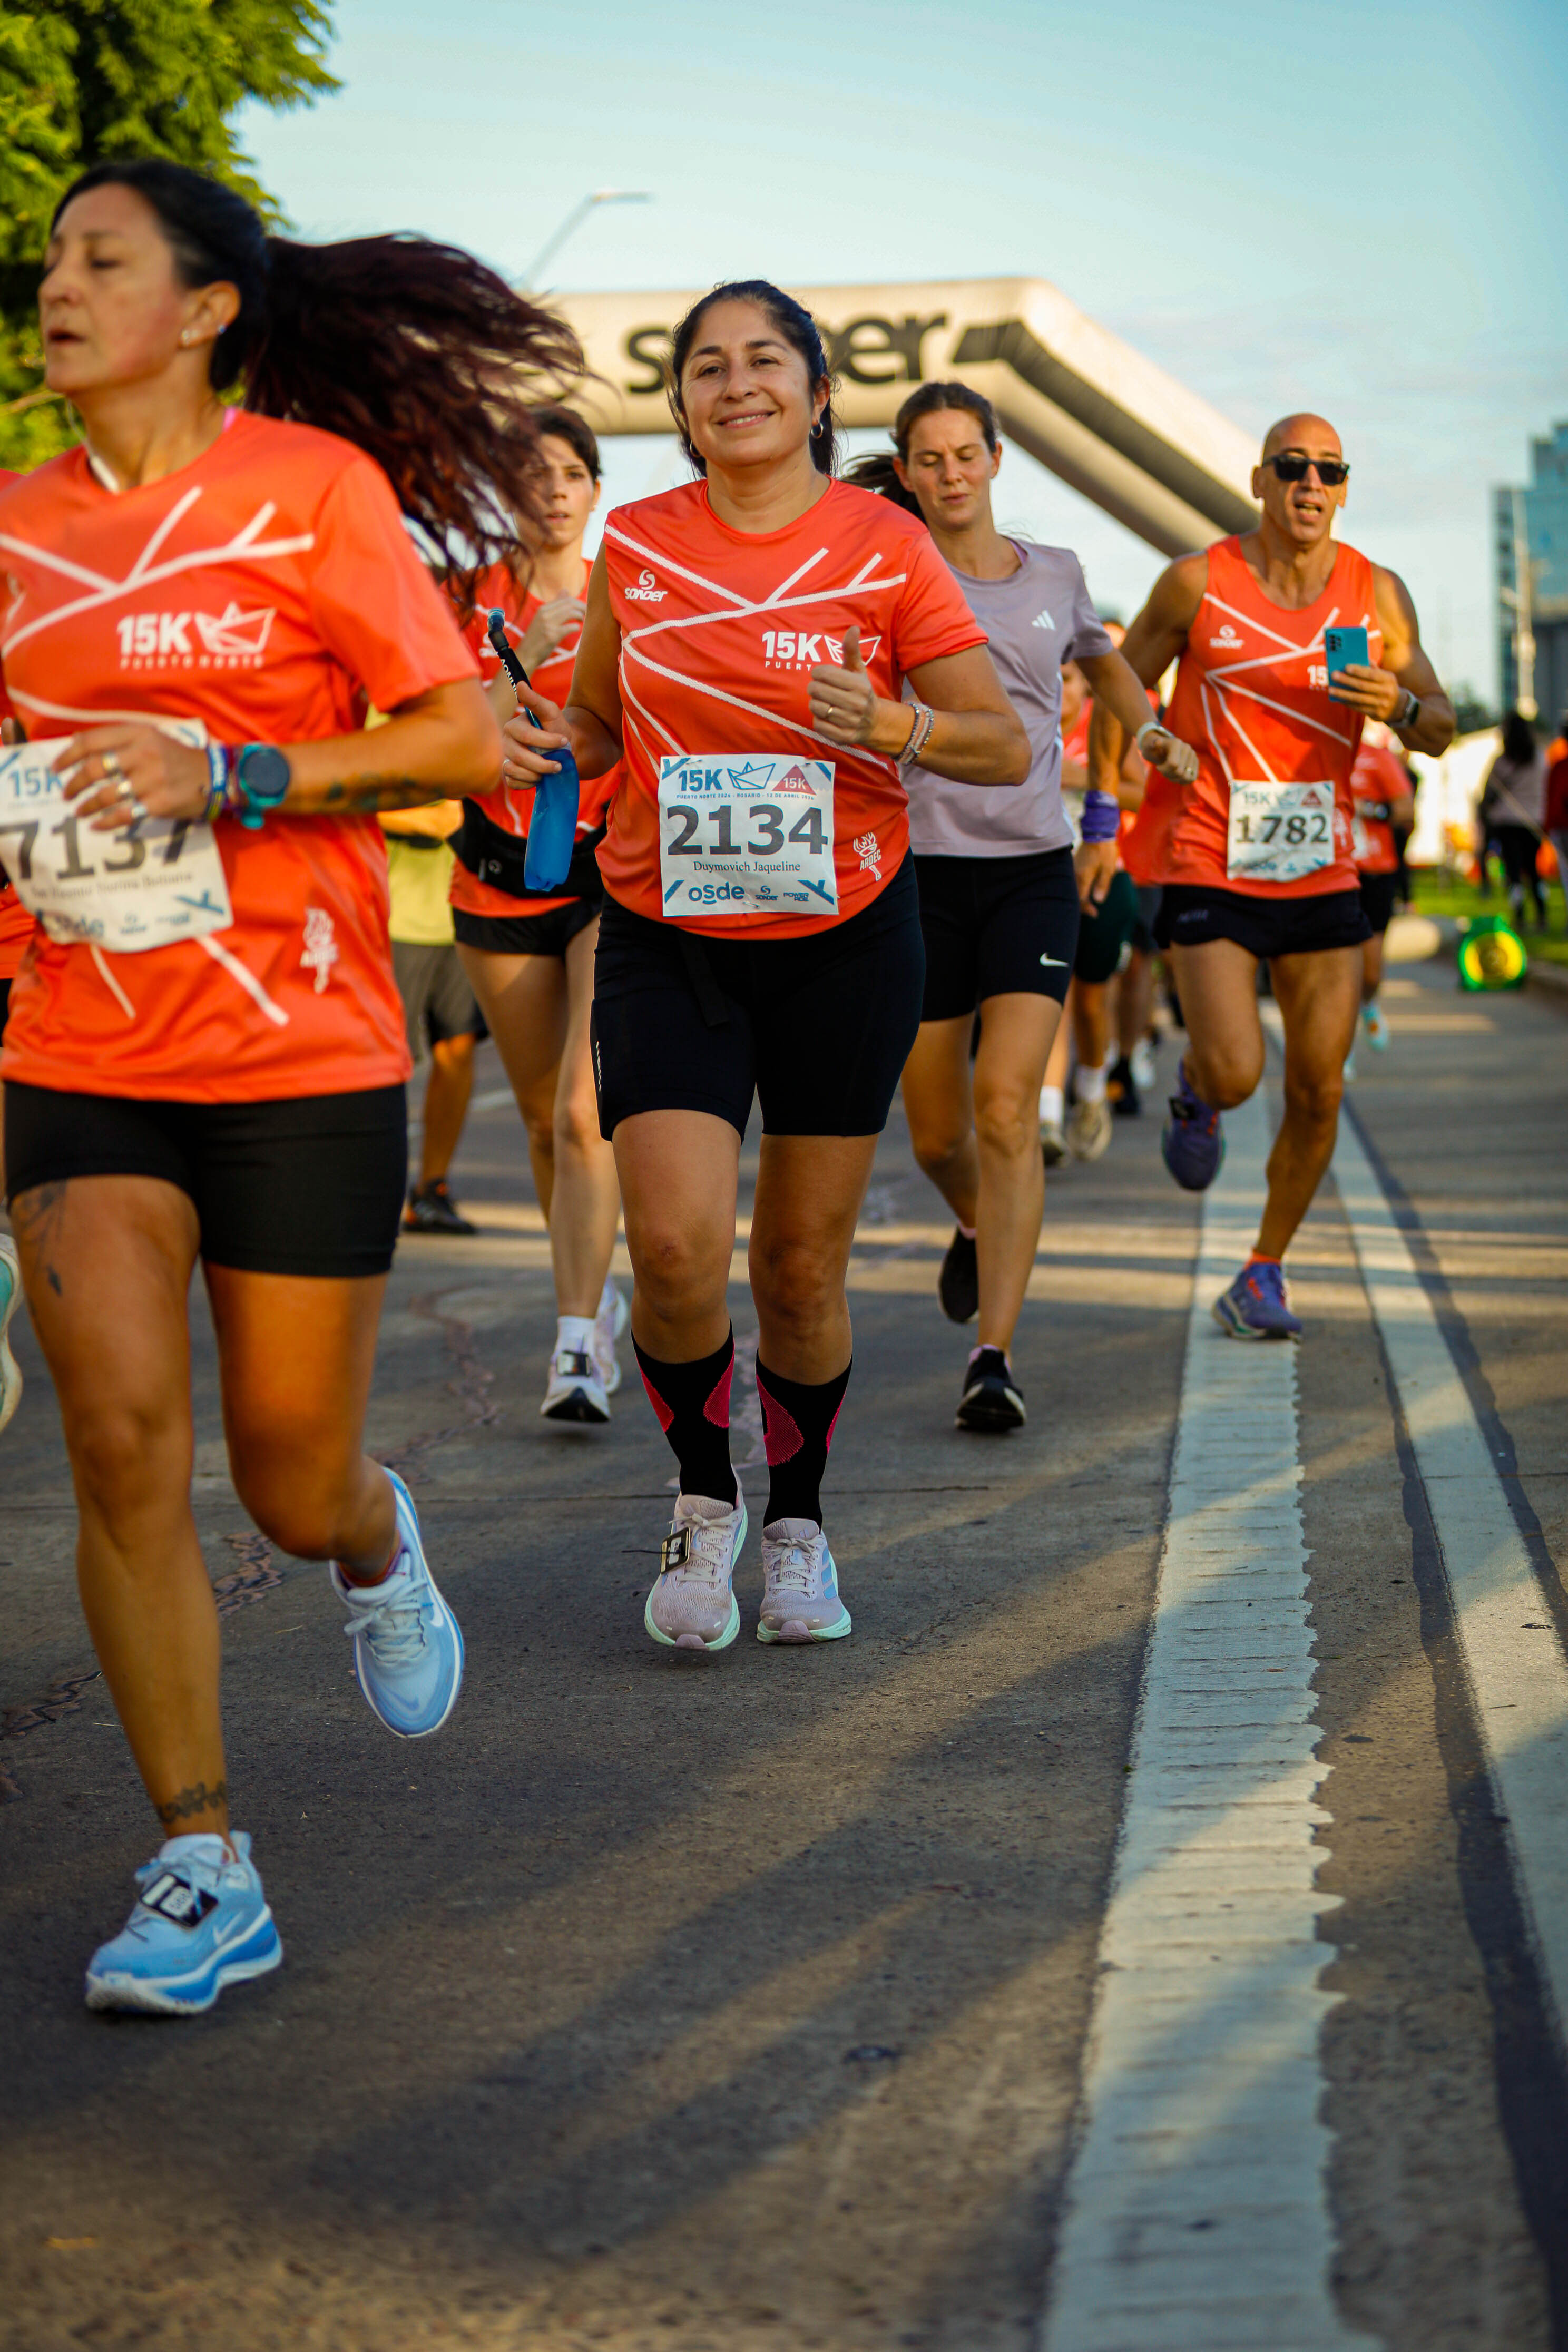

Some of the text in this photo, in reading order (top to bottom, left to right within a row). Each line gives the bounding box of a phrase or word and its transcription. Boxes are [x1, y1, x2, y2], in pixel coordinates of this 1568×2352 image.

[116, 612, 193, 656] 15K
[762, 631, 822, 662] 15K
[765, 661, 812, 672] PUERT
[1307, 665, 1329, 687] 15
[678, 768, 723, 792] 15K
[783, 777, 807, 790] 15K
[1243, 791, 1270, 805] 15K
[667, 803, 828, 855] 2134
[1235, 813, 1329, 844] 1782
[693, 861, 801, 874] Duymovich Jaqueline
[859, 849, 881, 871] ARDEC
[688, 881, 746, 904] osde
